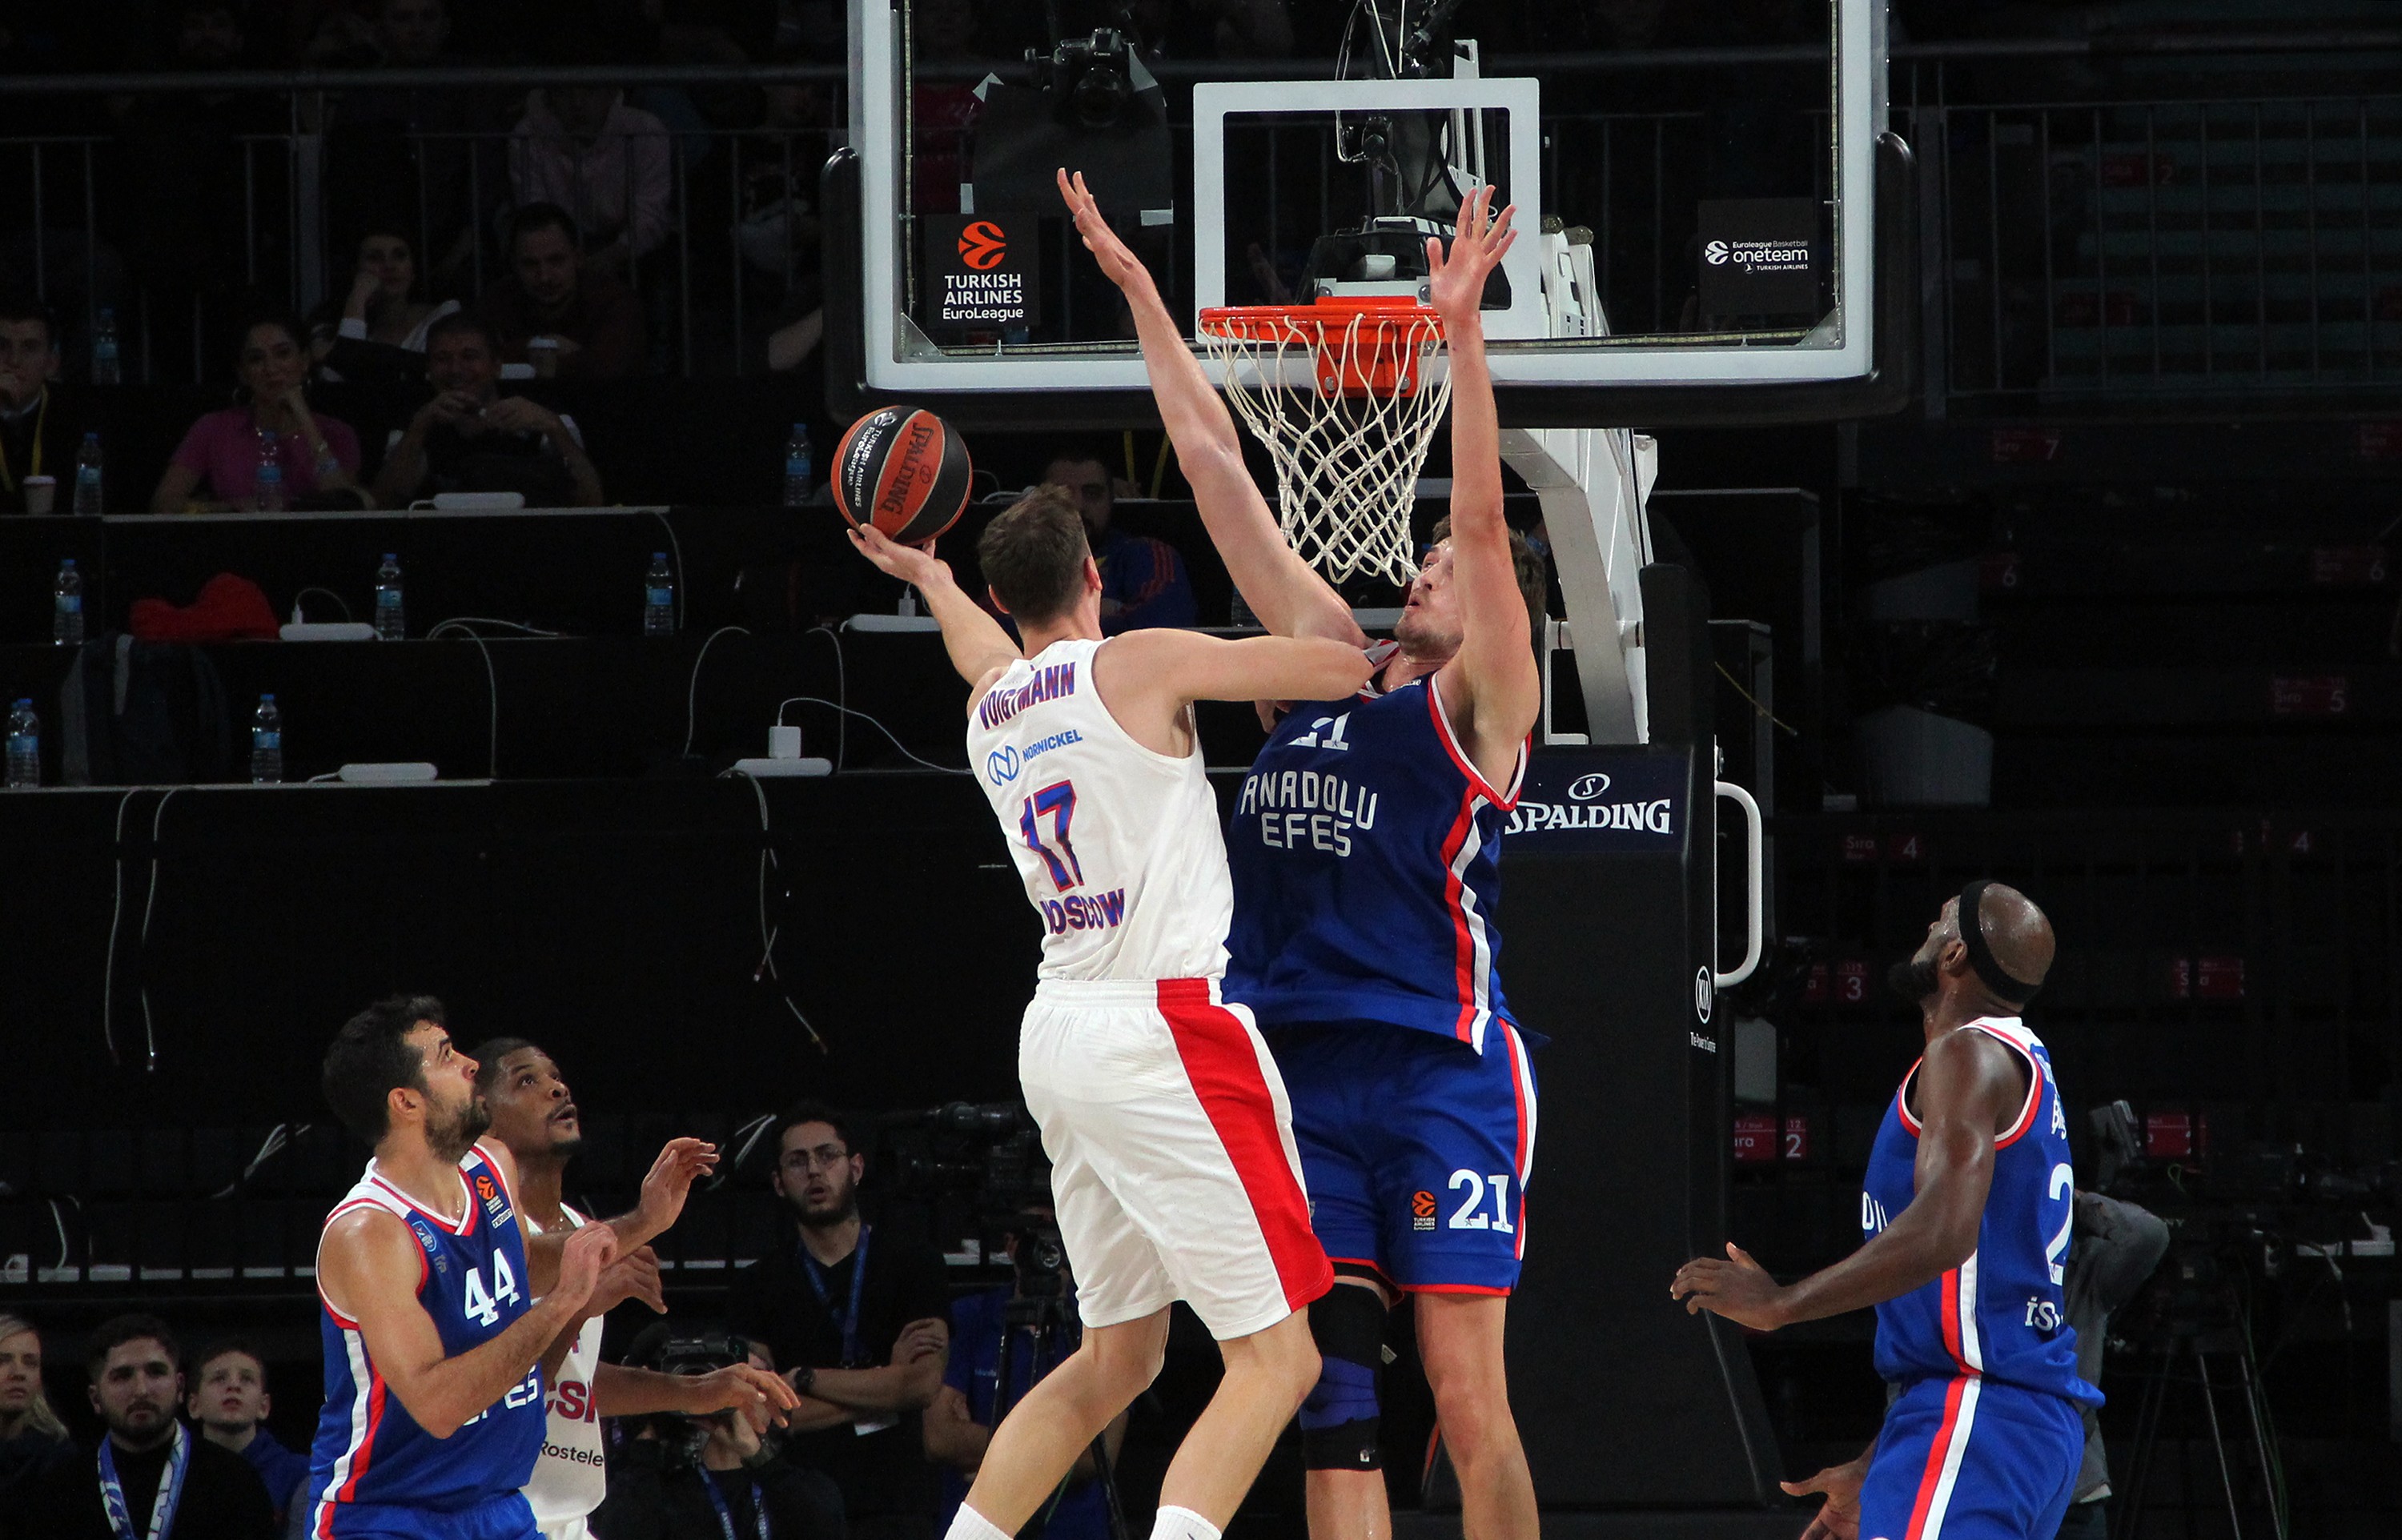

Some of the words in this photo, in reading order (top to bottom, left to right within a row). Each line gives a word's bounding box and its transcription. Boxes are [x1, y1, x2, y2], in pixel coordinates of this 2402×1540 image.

[1733, 241, 1772, 249] Euroleague
[1733, 247, 1808, 263] oneteam
[944, 274, 1022, 289] TURKISH
[944, 290, 1022, 305] AIRLINES
[942, 307, 1024, 322] EuroLeague
[847, 426, 874, 486] EuroLeague
[860, 428, 882, 466] TURKISH
[881, 422, 934, 515] SPALDING
[854, 467, 865, 507] AIRLINES
[2003, 564, 2017, 587] 6
[2331, 690, 2344, 712] 5
[1022, 729, 1083, 762] NORNICKEL
[1240, 771, 1378, 830] ANADOLU
[1504, 799, 1671, 835] SPALDING
[1019, 780, 1085, 893] 17
[1261, 812, 1352, 857] EFES
[1902, 836, 1918, 859] 4
[1846, 977, 1862, 1000] 3
[1786, 1133, 1801, 1157] 2
[1448, 1169, 1514, 1234] 21
[464, 1248, 520, 1328] 44
